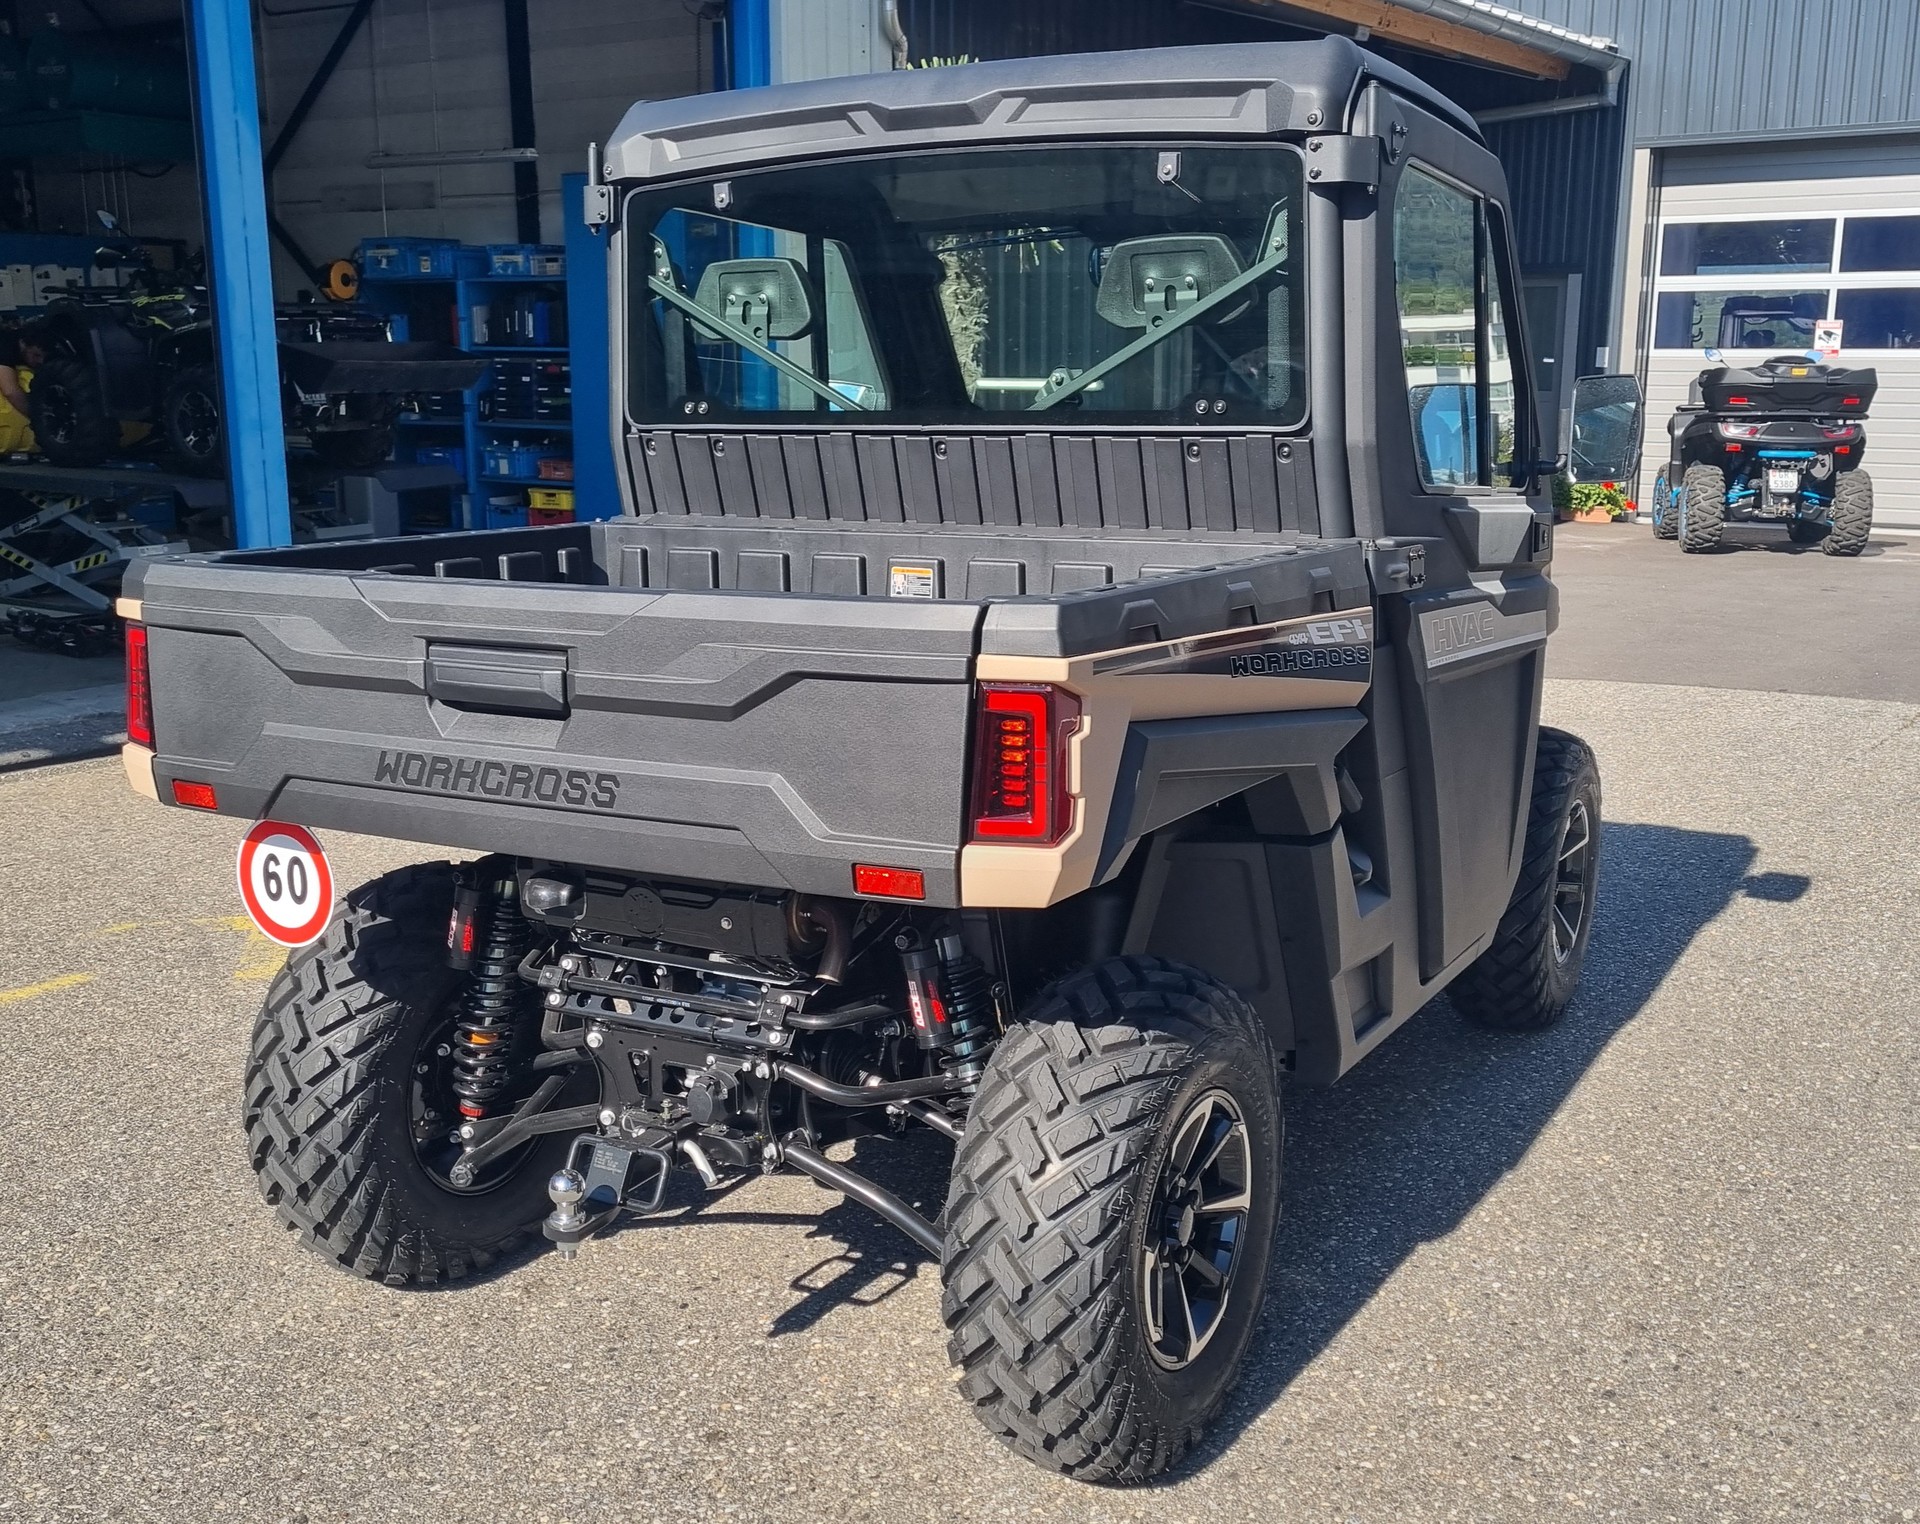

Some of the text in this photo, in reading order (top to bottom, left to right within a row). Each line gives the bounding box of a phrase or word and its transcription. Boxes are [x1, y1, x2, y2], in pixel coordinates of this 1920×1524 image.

[1306, 619, 1368, 645] EFI
[1431, 608, 1495, 654] HVAC
[1230, 645, 1371, 678] WORKCROSS
[373, 750, 621, 809] WORKCROSS
[263, 853, 308, 905] 60
